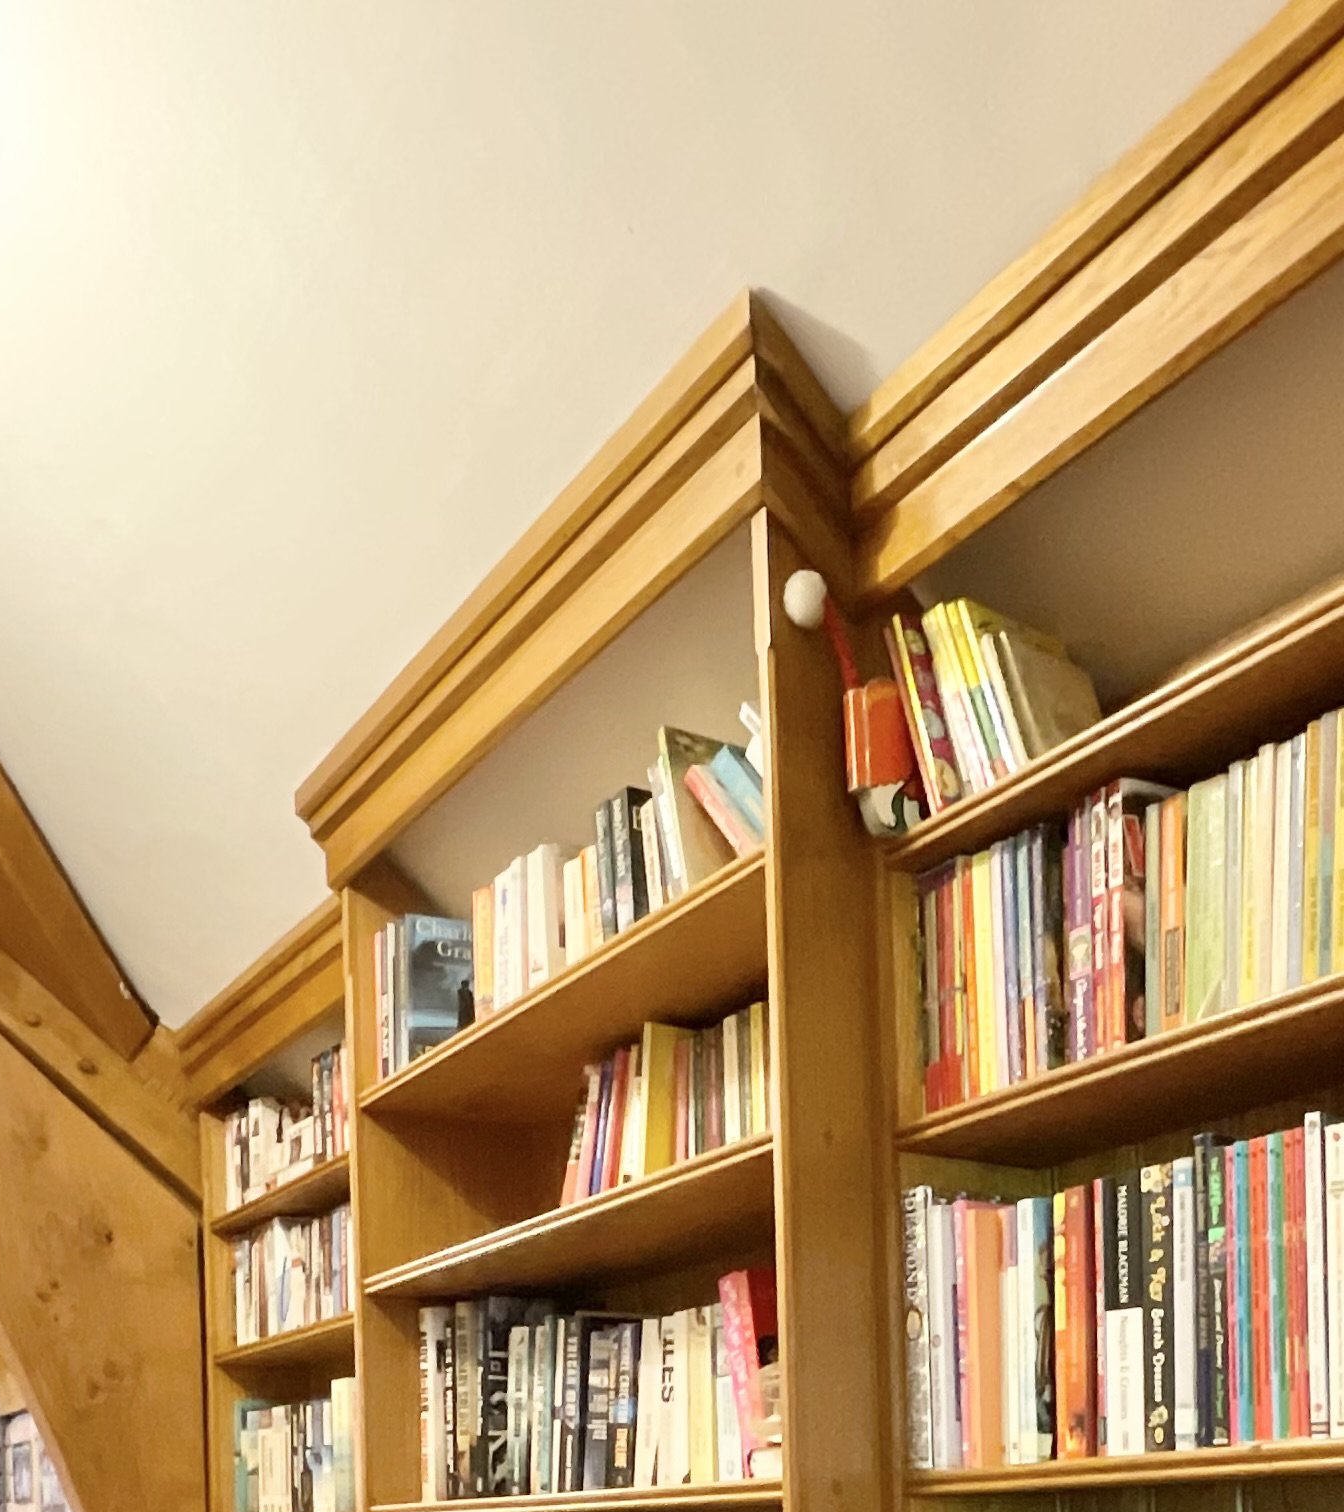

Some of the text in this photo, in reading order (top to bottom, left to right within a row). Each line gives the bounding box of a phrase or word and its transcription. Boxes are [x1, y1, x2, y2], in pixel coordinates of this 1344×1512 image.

[1116, 1186, 1130, 1303] MALORIE BLACKMAN
[1151, 1308, 1165, 1349] Sarah
